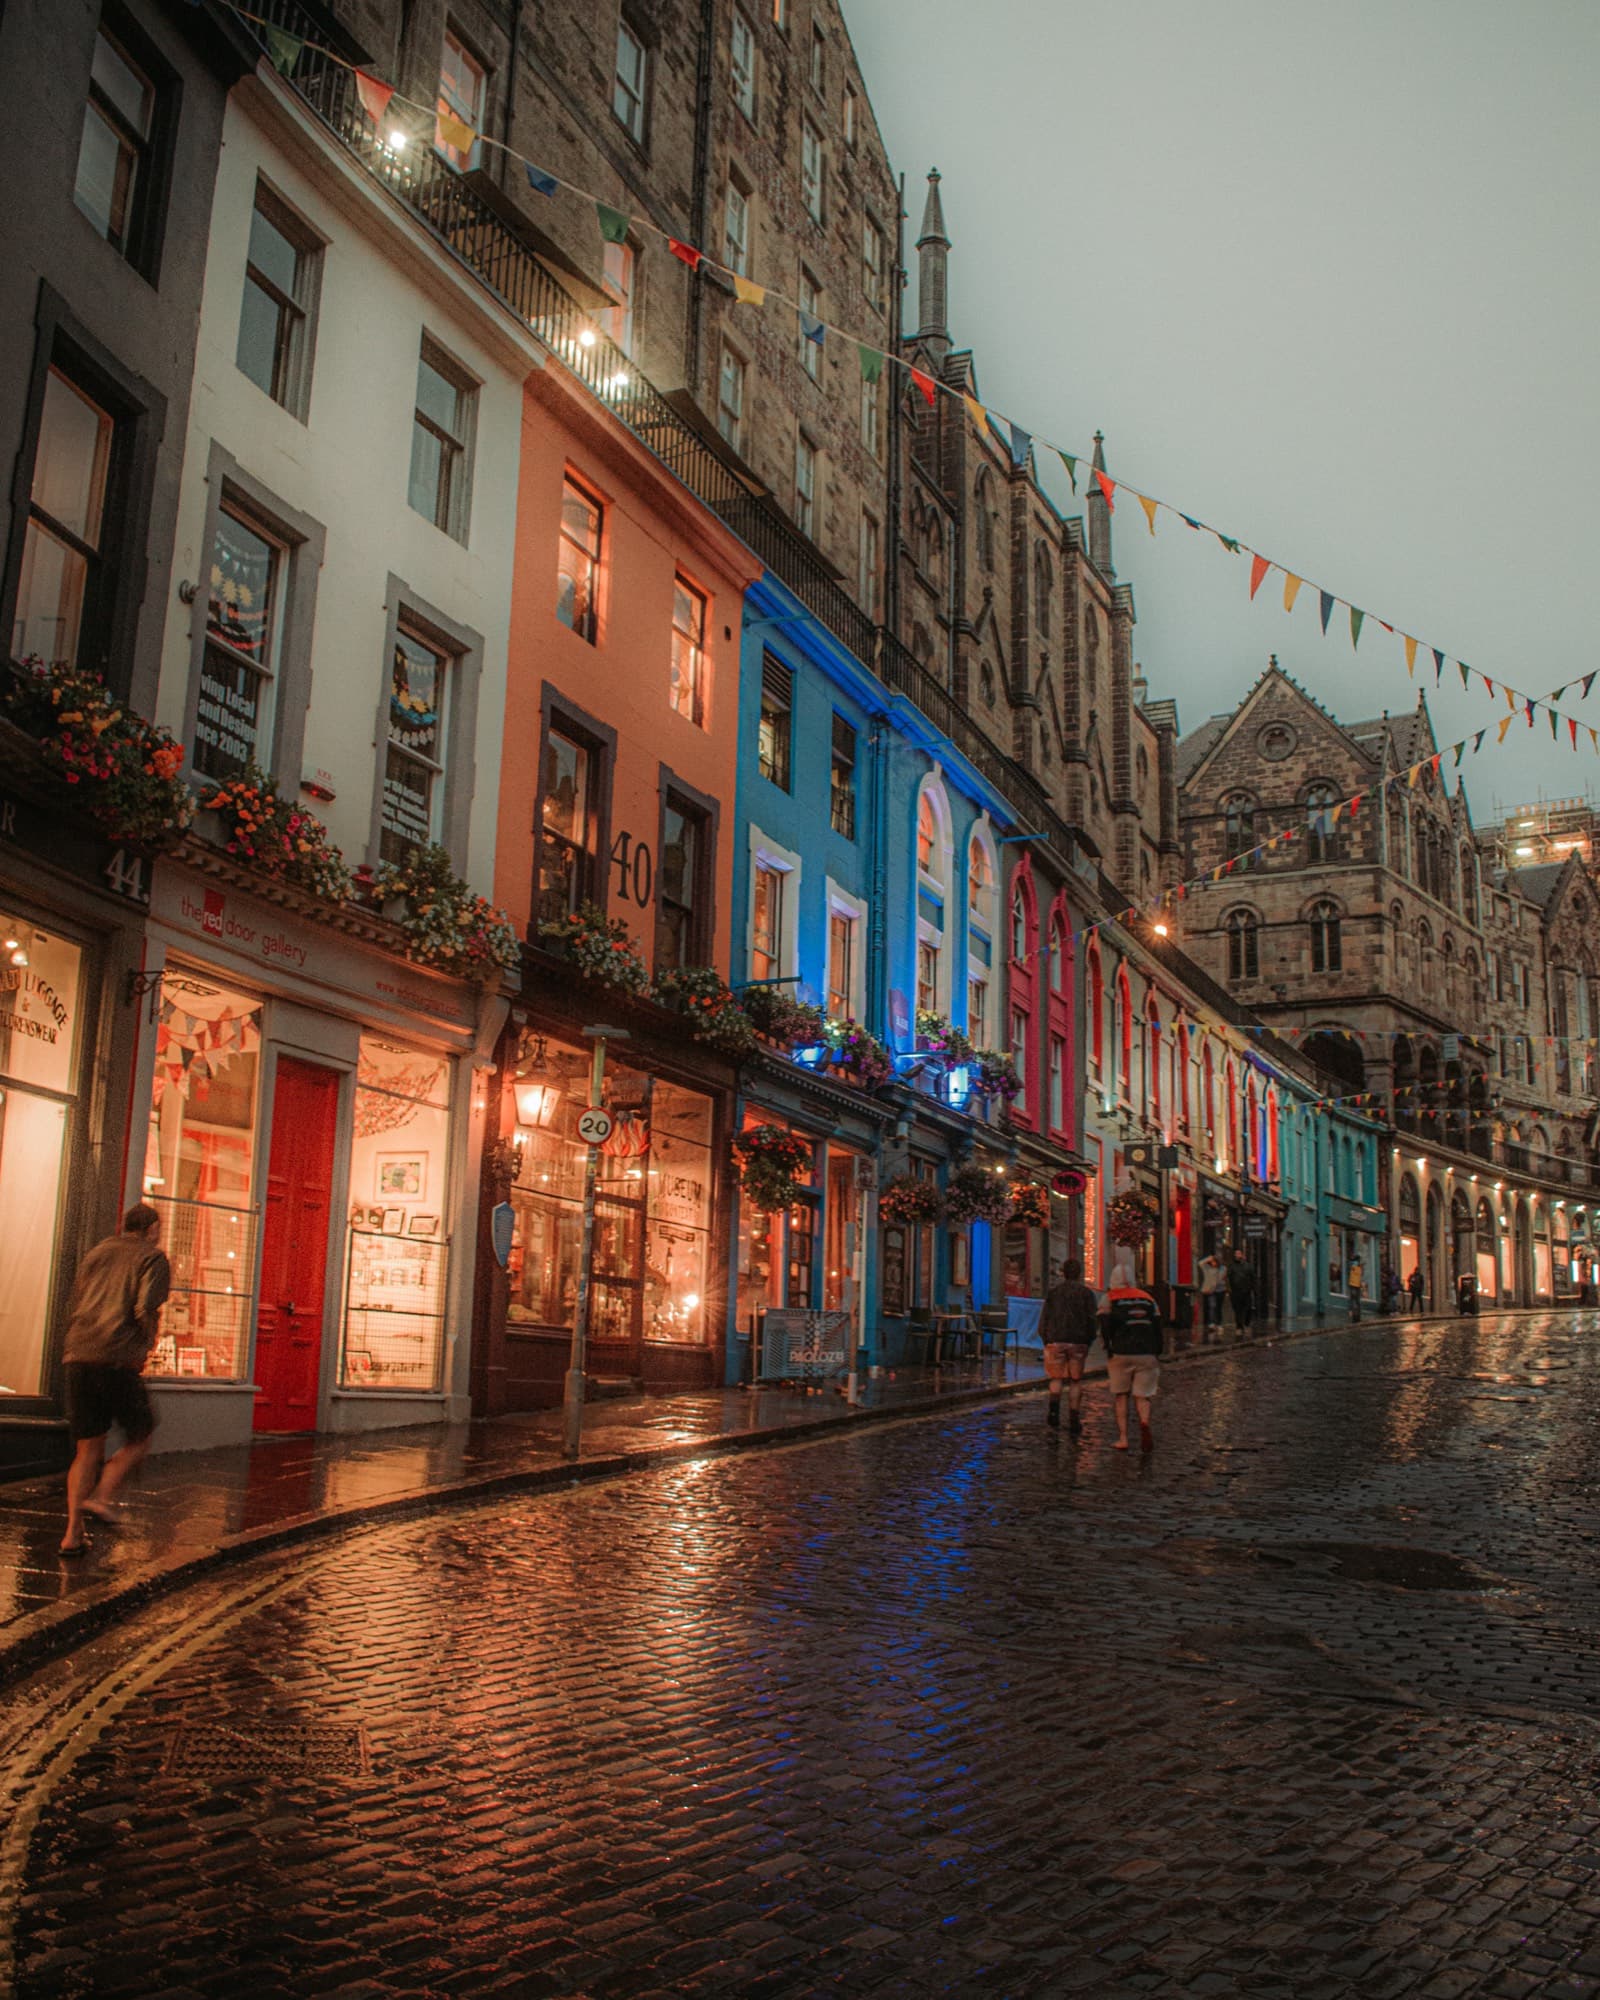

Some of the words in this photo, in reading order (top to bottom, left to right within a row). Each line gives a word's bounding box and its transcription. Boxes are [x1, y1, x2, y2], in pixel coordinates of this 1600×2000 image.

[198, 698, 220, 723] and
[226, 685, 256, 720] Local
[218, 731, 248, 763] 2003
[104, 848, 143, 900] 44
[610, 830, 652, 909] 40
[181, 896, 203, 922] the
[203, 908, 224, 931] red
[225, 914, 257, 943] door
[262, 934, 308, 967] gallery
[25, 970, 69, 1032] LUGGAGE
[581, 1117, 609, 1136] 20
